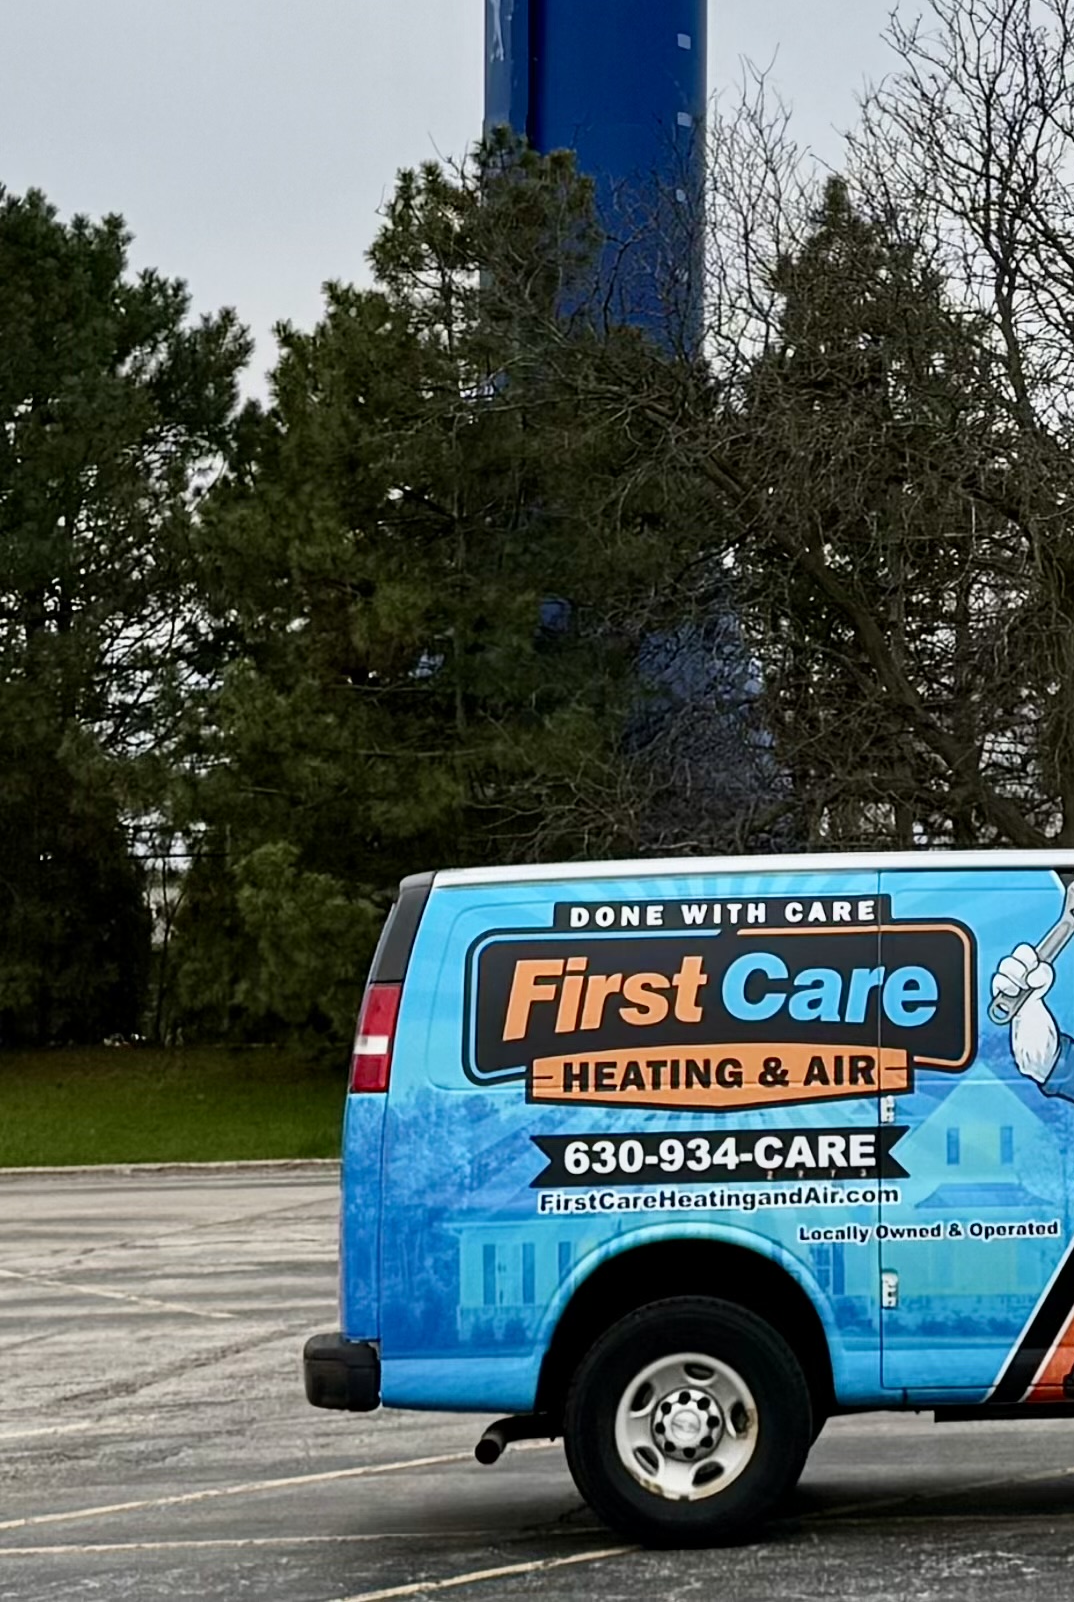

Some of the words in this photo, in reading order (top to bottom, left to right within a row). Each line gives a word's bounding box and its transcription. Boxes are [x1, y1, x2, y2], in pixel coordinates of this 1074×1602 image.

[570, 904, 665, 928] DONE
[681, 902, 767, 925] WITH
[784, 899, 876, 922] CARE
[502, 955, 708, 1042] First
[721, 952, 938, 1028] Care
[562, 1057, 744, 1093] HEATING
[758, 1056, 790, 1088] &
[803, 1054, 877, 1087] AIR
[563, 1134, 877, 1175] 630-934-CARE
[540, 1188, 898, 1211] FirstCareHeatingandAir.com
[799, 1225, 869, 1243] Locally
[876, 1224, 942, 1240] Owned
[948, 1222, 962, 1237] &
[969, 1221, 1059, 1241] Operated
